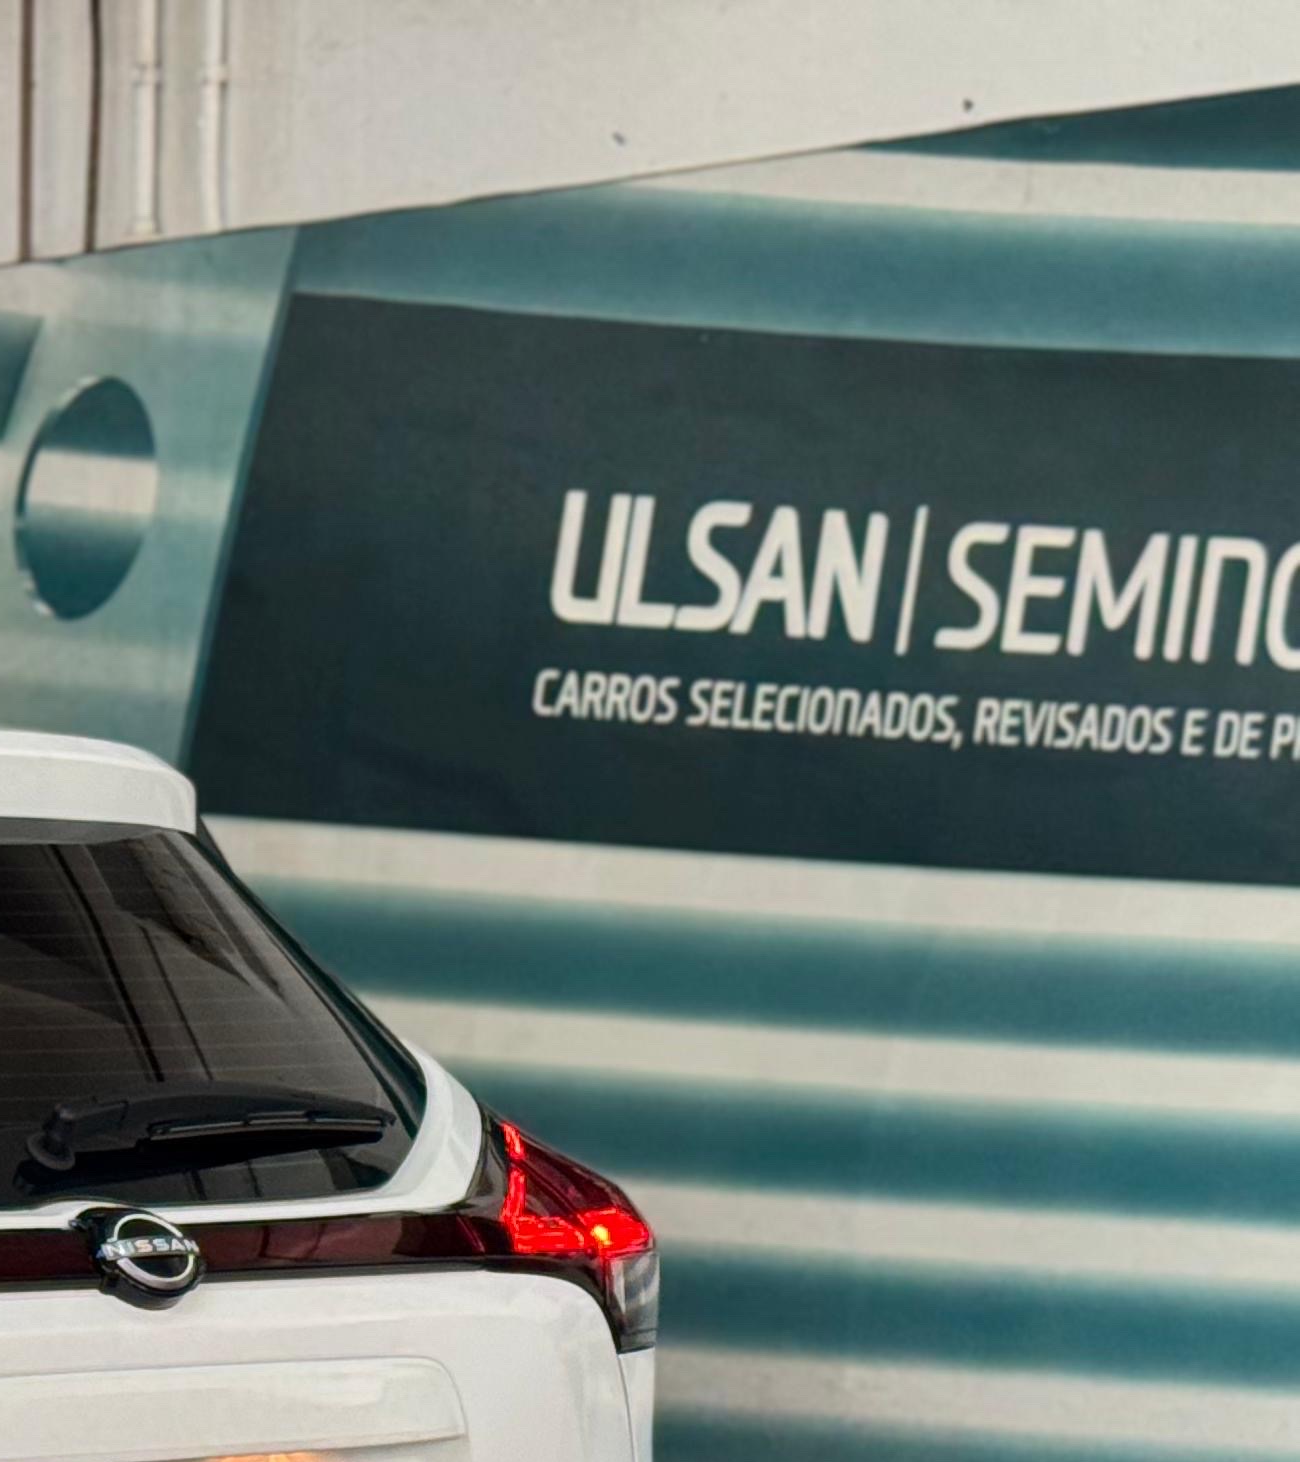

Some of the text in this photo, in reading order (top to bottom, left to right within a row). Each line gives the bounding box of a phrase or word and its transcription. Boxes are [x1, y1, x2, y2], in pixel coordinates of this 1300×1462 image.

[551, 490, 888, 642] ULSAN
[532, 668, 1300, 761] CARROS SELECIONADOS, REVISADOS E DE P
[101, 1238, 200, 1260] NISSAN
